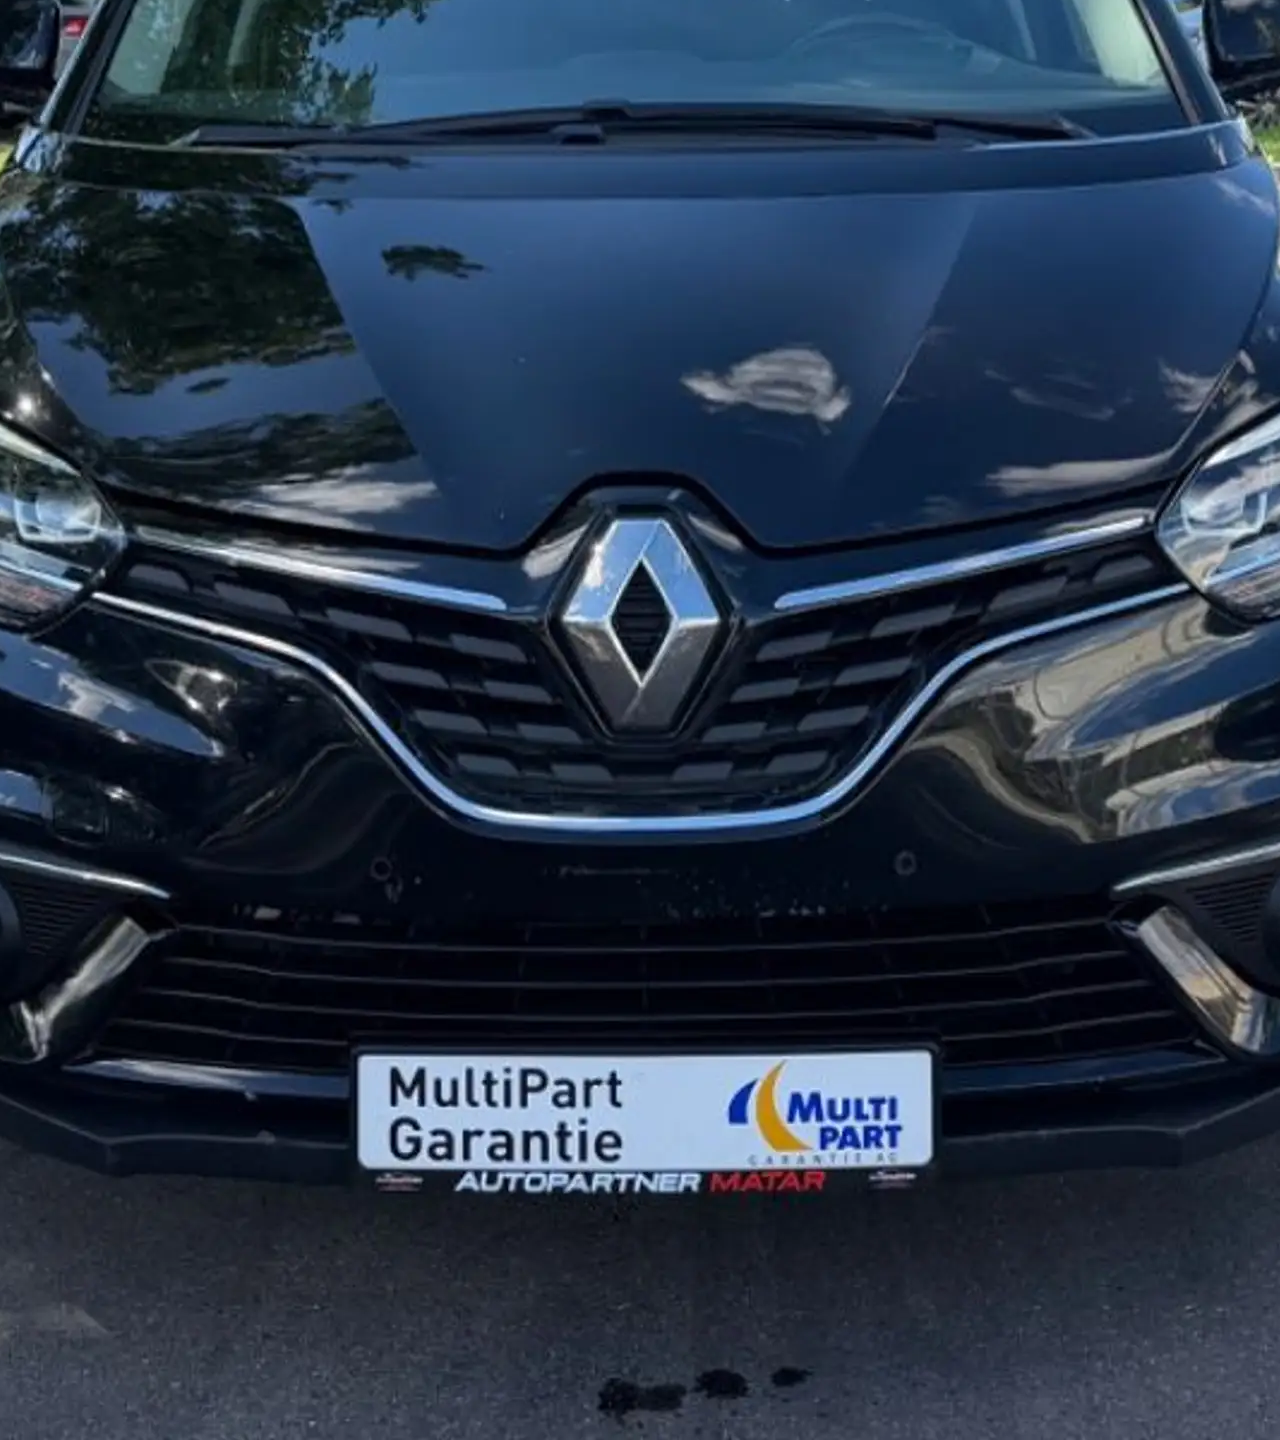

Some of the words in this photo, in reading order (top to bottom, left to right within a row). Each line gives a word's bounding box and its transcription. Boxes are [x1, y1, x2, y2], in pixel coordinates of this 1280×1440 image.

[389, 1066, 622, 1109] MultiPart
[389, 1116, 622, 1162] Garantie
[820, 1125, 902, 1150] PART
[455, 1171, 701, 1193] AUTOPARTNER
[709, 1171, 825, 1192] MATAR
